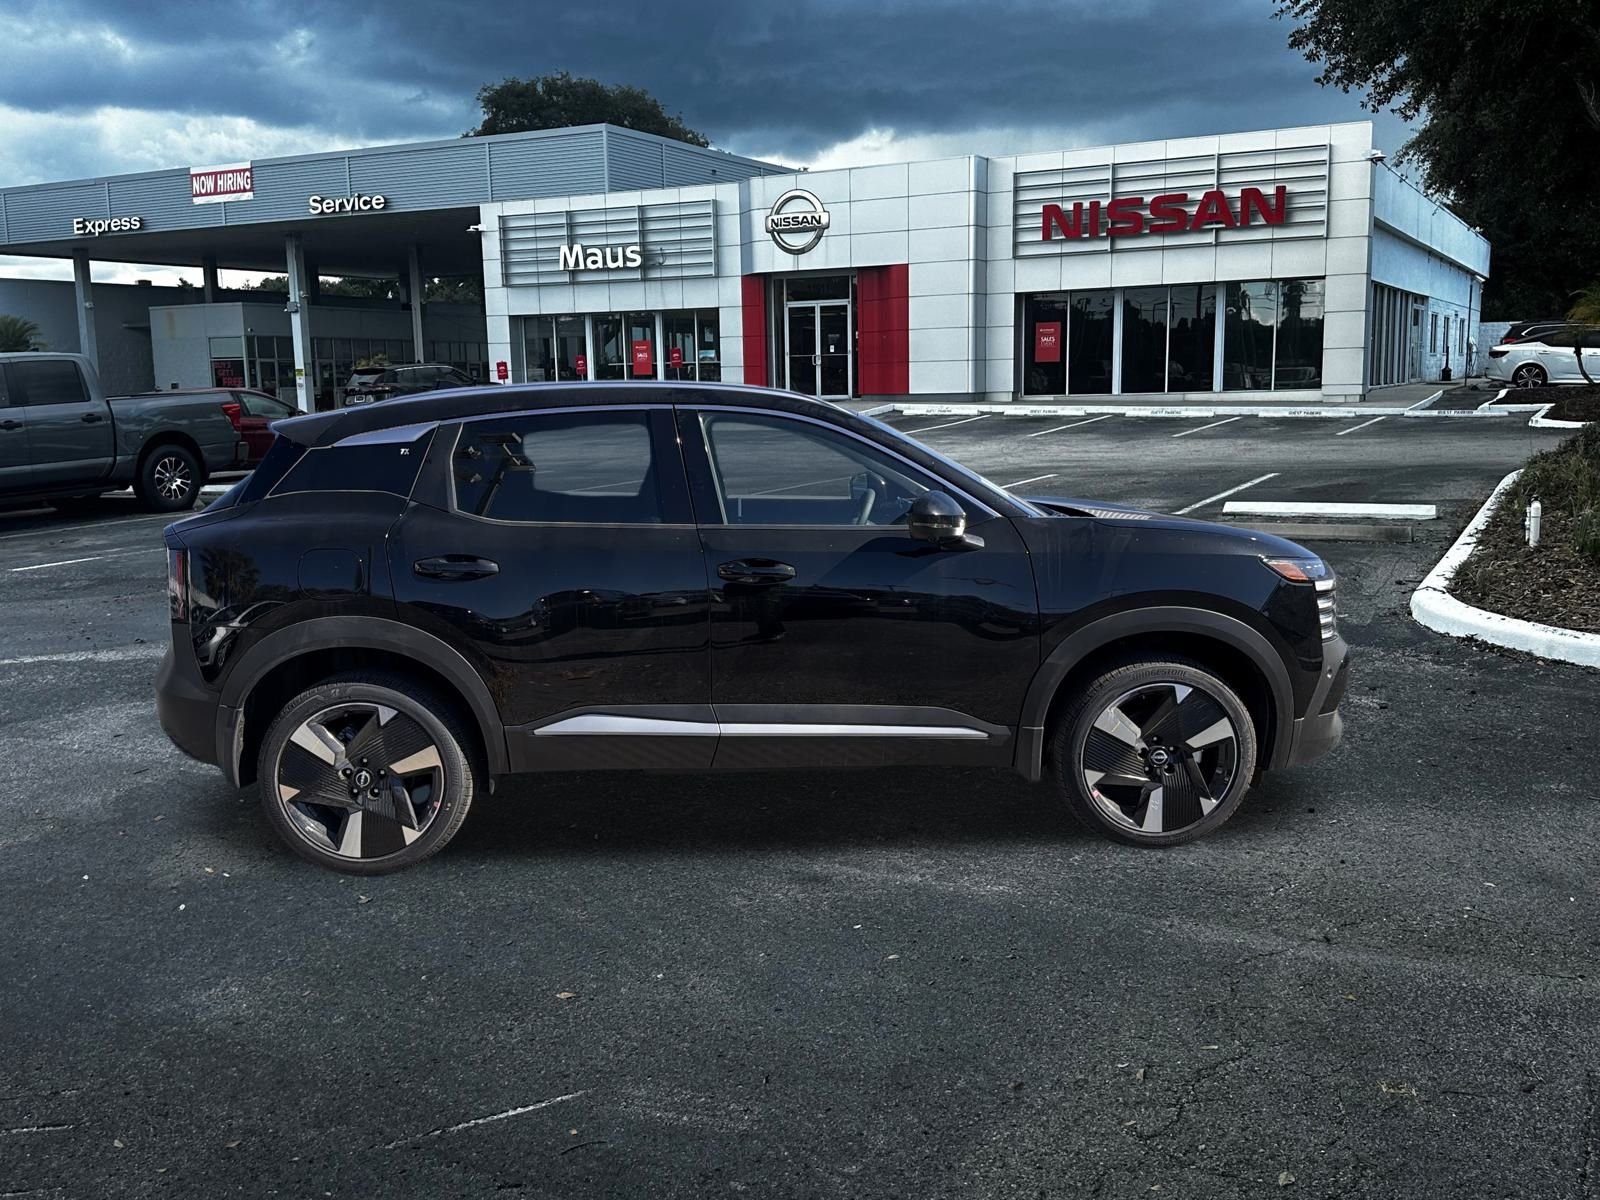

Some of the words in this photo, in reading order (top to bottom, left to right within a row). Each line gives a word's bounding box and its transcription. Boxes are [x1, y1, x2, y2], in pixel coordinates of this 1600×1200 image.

[192, 174, 215, 195] NOW
[217, 170, 251, 193] HIRING
[308, 193, 386, 215] Service
[1041, 185, 1287, 241] NISSAN
[72, 215, 142, 237] Express
[769, 214, 823, 230] NISSAN
[558, 243, 642, 271] Maus
